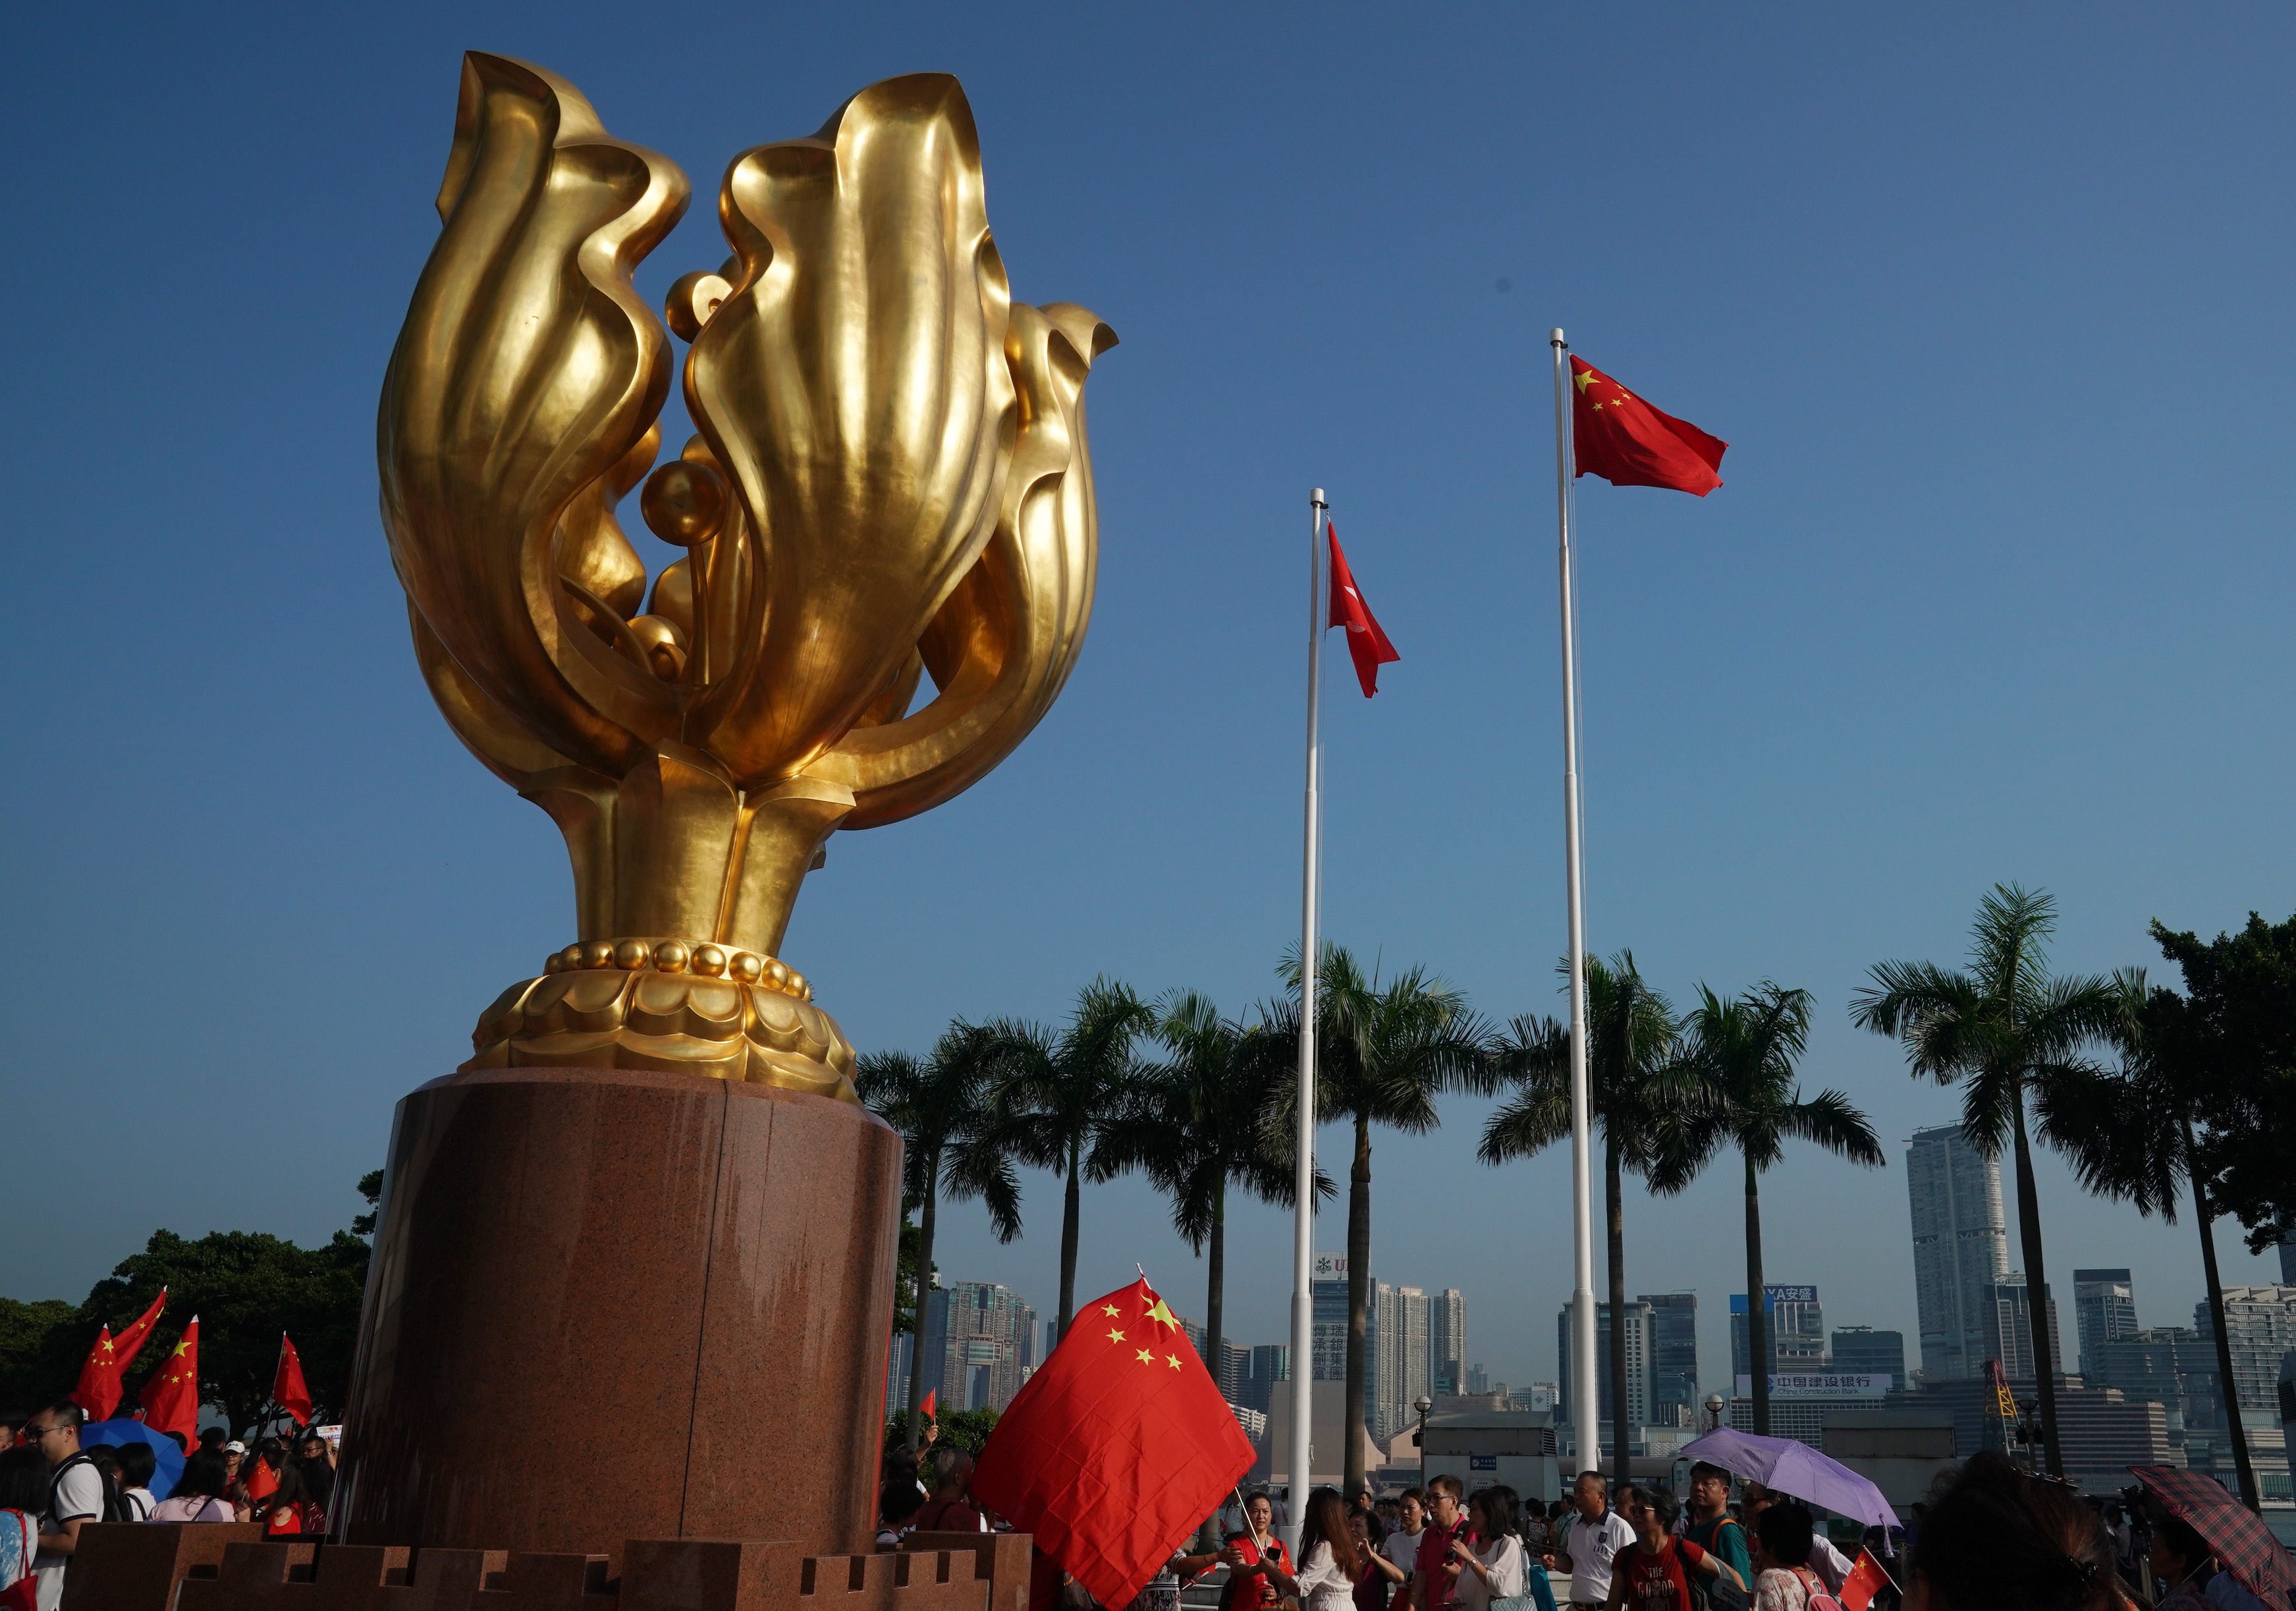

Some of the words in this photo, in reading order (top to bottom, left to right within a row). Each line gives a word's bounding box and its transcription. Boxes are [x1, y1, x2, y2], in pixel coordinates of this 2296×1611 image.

[1313, 1324, 1327, 1380] 傳承創富
[1330, 1324, 1344, 1380] 瑞銀集團
[1778, 1376, 1871, 1387] 中国建设银行
[1648, 1567, 1663, 1578] THE
